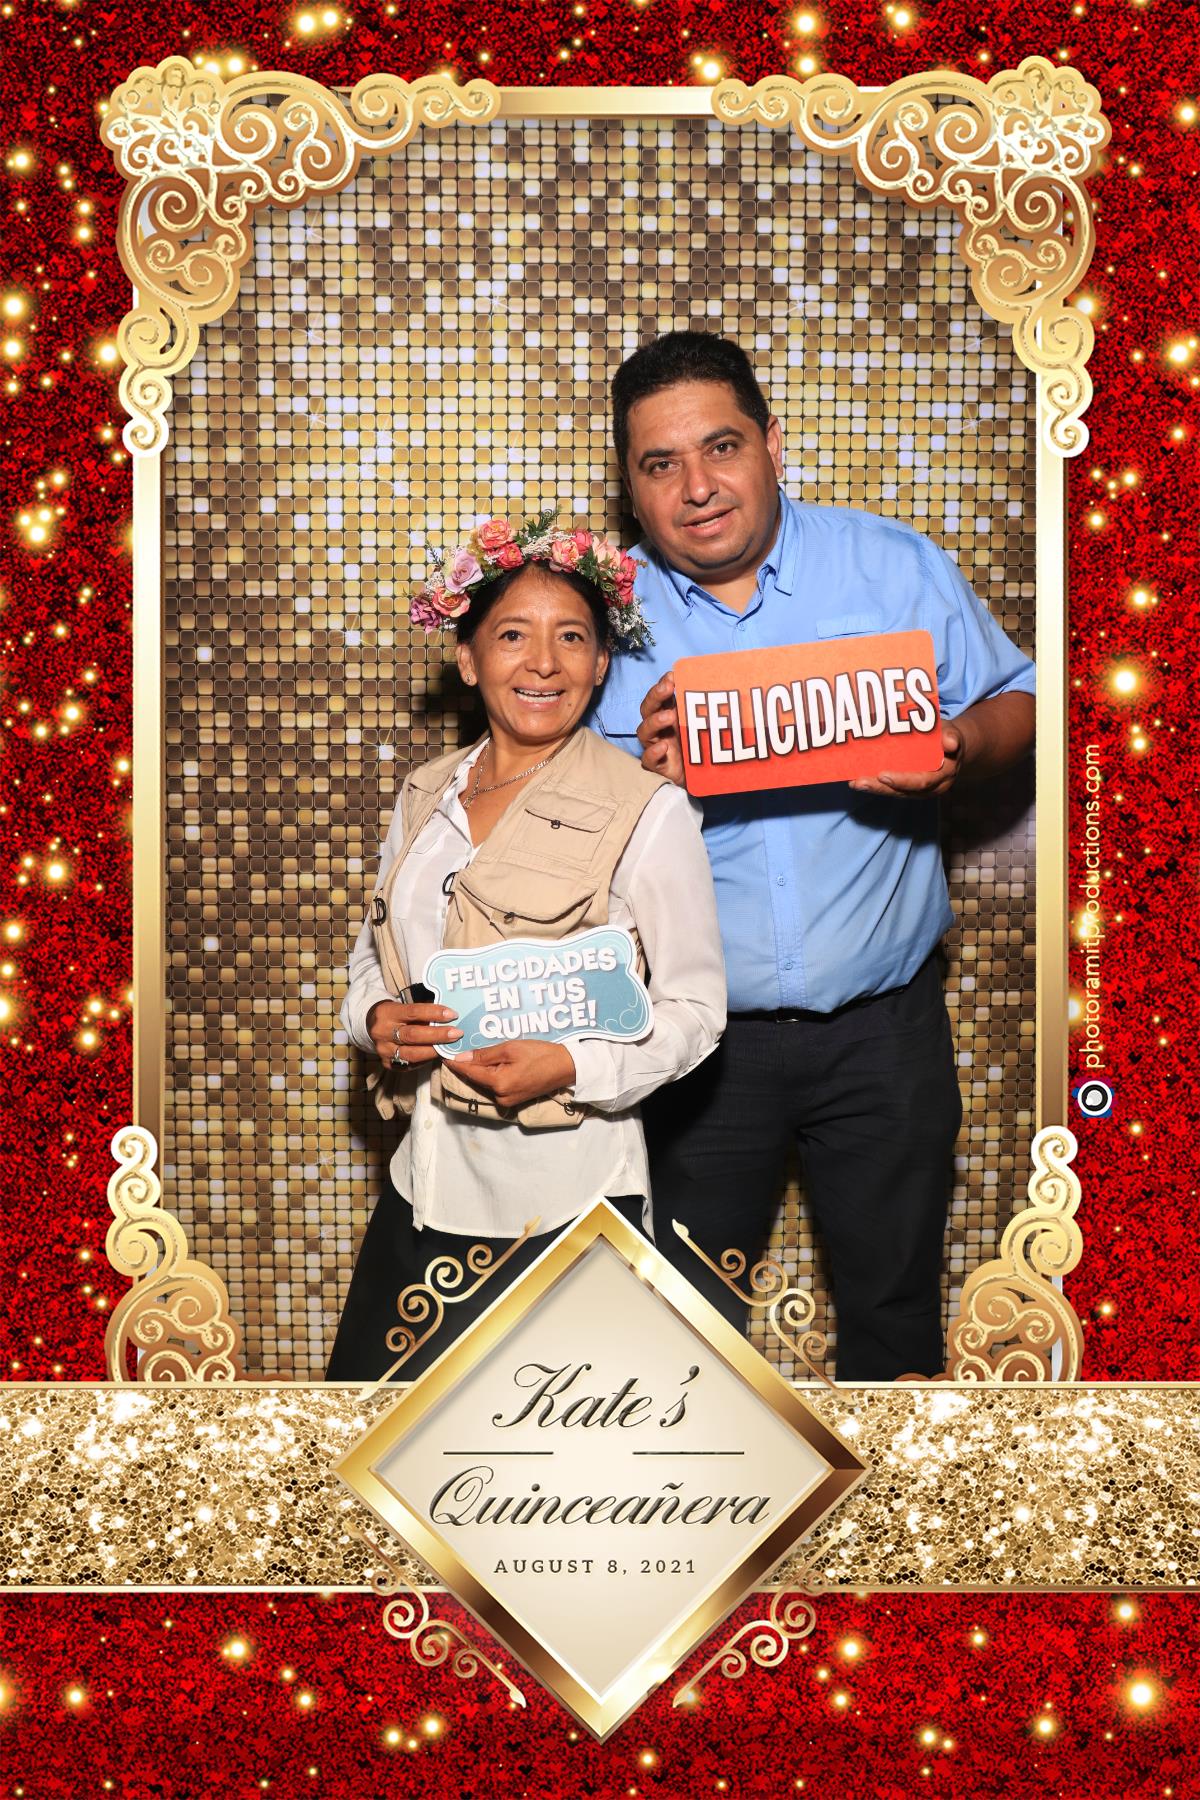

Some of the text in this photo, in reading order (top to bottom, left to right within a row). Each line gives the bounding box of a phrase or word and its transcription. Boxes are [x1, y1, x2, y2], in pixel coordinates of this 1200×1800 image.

[684, 667, 938, 766] FELICIDADES
[444, 946, 618, 992] FELICIDADES
[483, 976, 587, 1012] EN TUS
[478, 999, 598, 1040] QUINCE!
